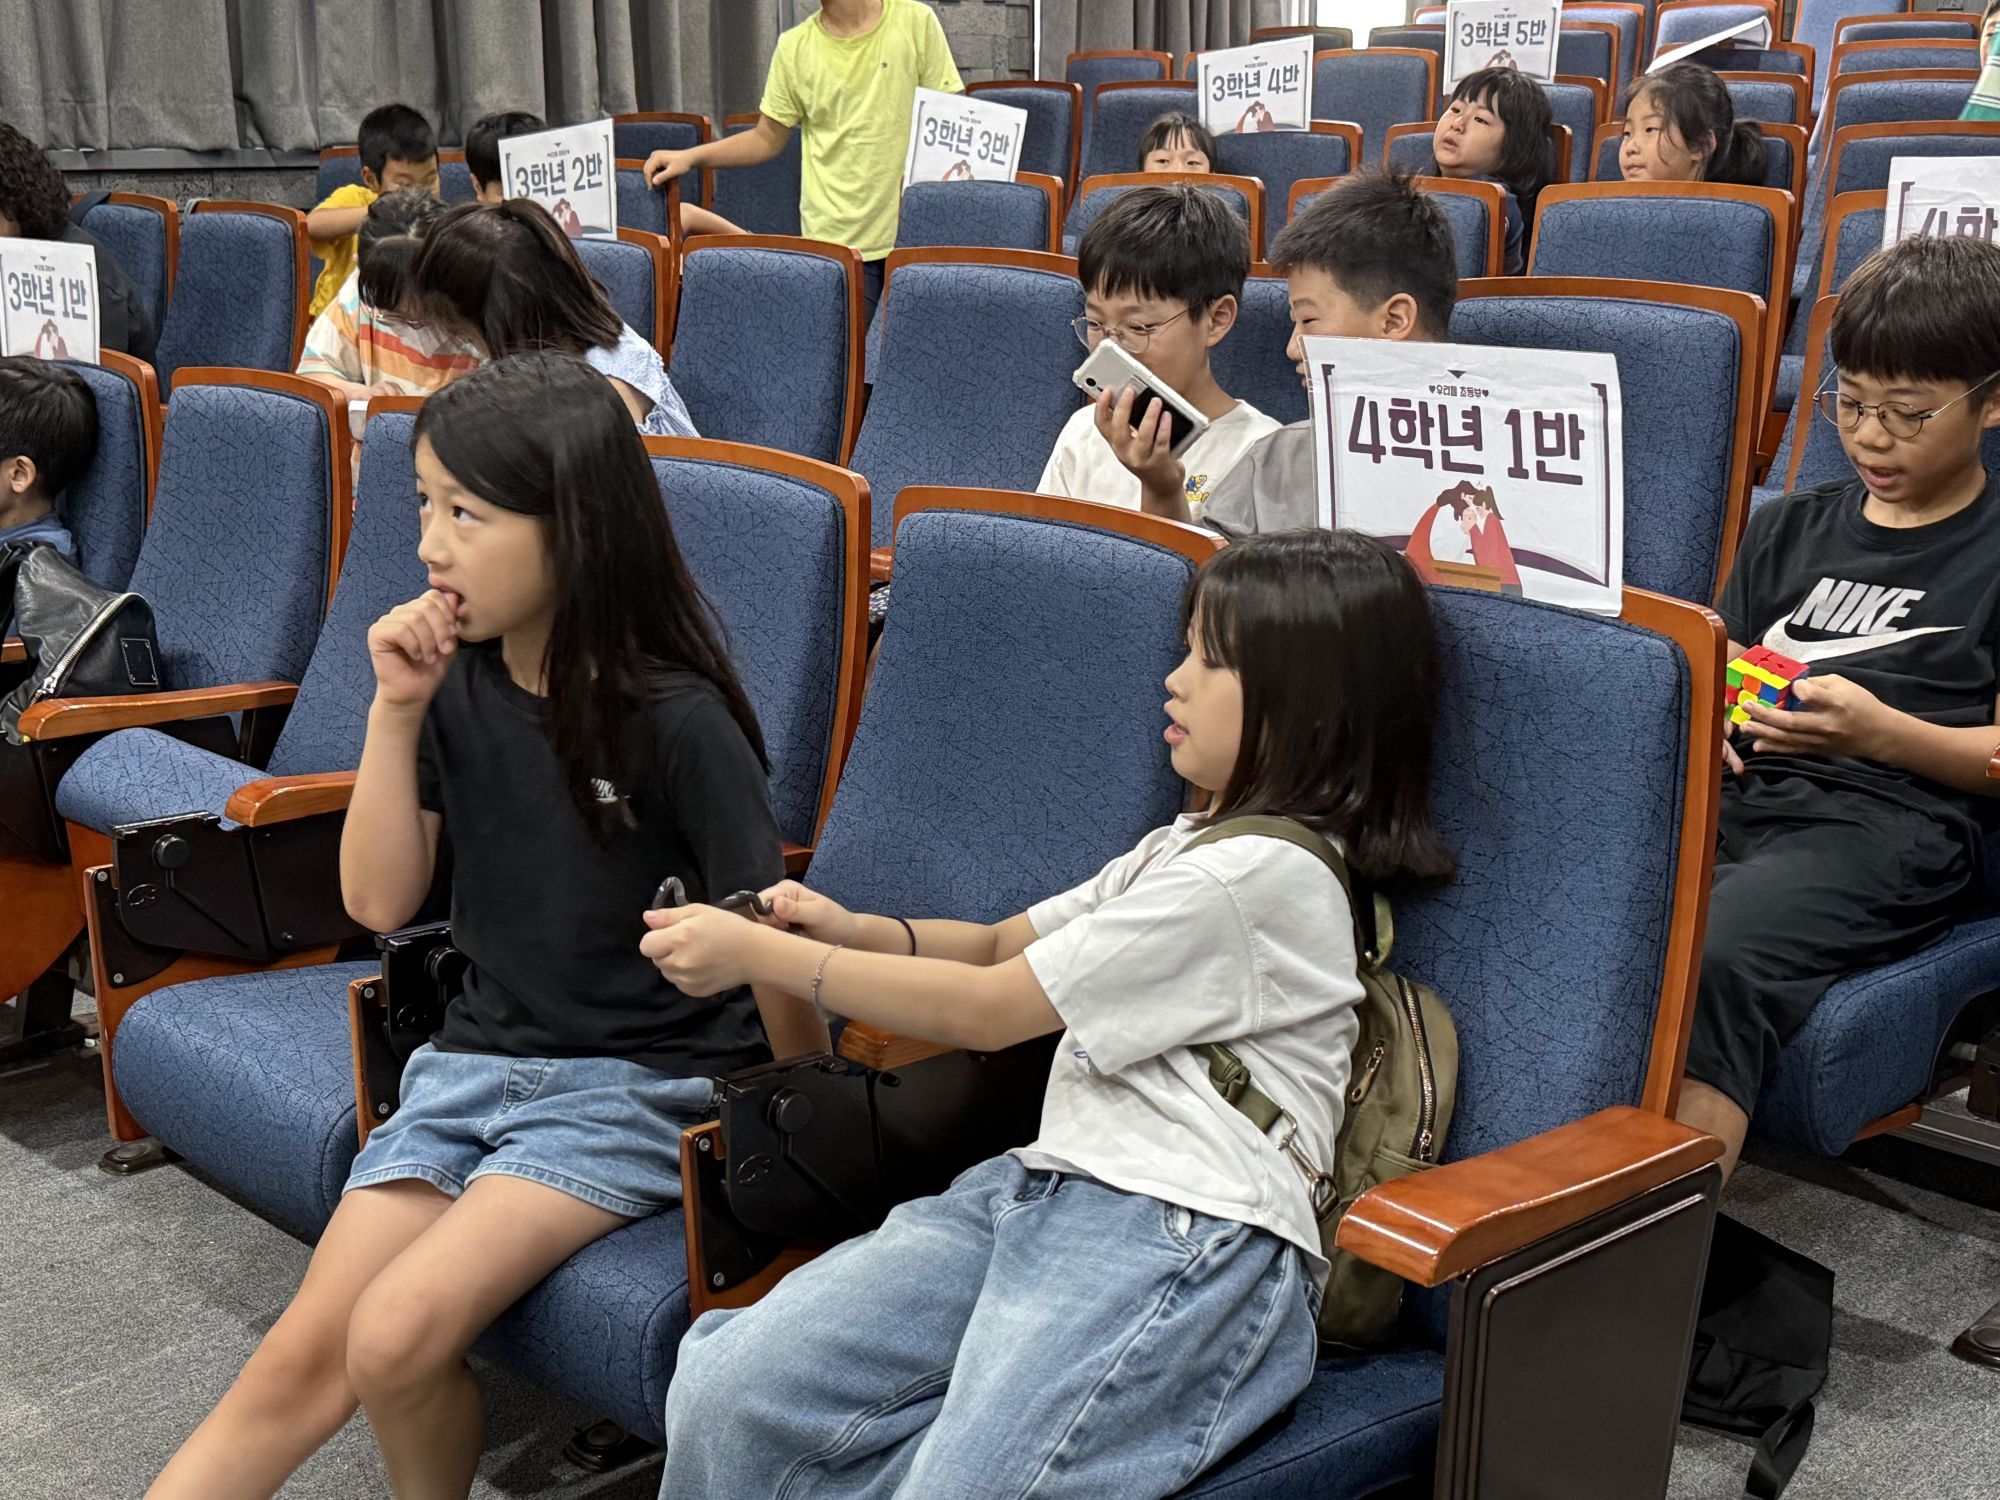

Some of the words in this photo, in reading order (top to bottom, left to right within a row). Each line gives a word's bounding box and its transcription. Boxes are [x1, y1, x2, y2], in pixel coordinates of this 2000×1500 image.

[1460, 20, 1510, 47] 3학년
[1515, 19, 1547, 46] 5반
[1212, 69, 1261, 103] 3학년
[1267, 62, 1299, 94] 4반
[923, 117, 974, 157] 3학년
[977, 130, 1010, 166] 3반
[515, 159, 567, 198] 3학년
[572, 152, 603, 192] 2반
[8, 271, 56, 317] 3학년
[60, 276, 88, 321] 1반
[1348, 395, 1485, 475] 4학년
[1504, 408, 1585, 486] 1반
[1790, 577, 1927, 636] NIKE
